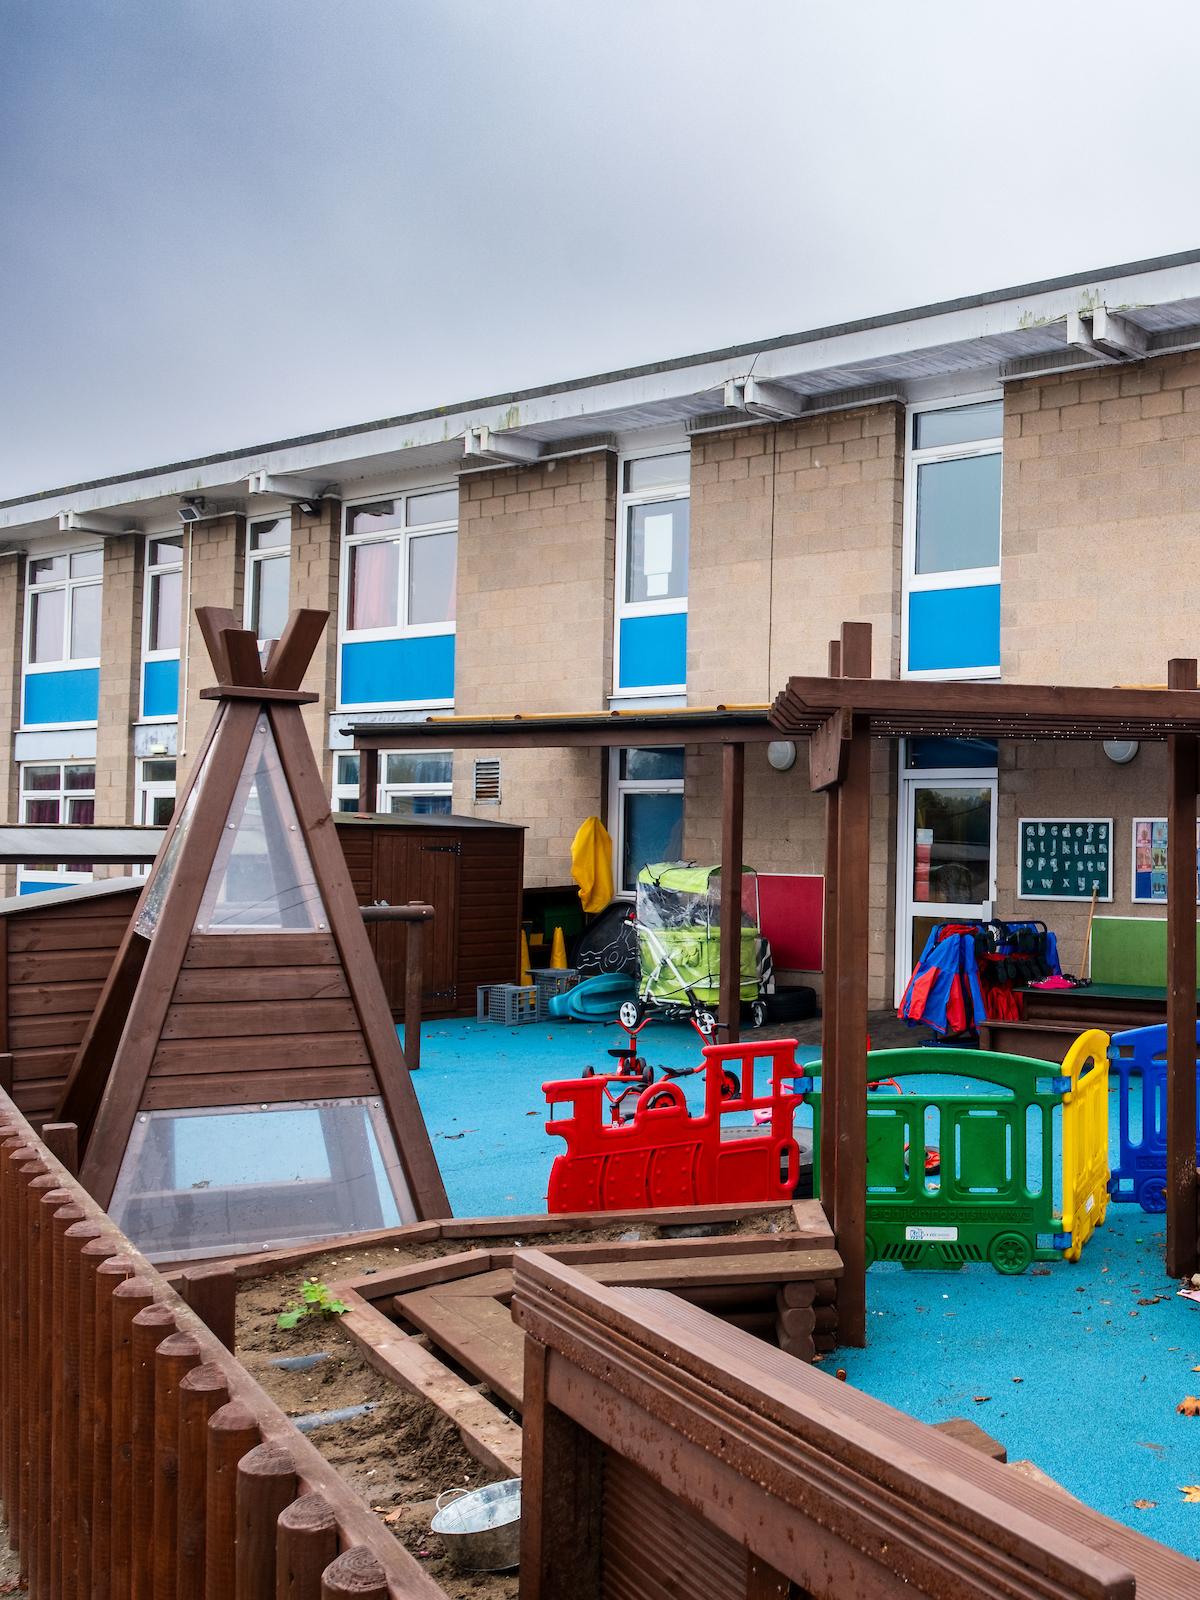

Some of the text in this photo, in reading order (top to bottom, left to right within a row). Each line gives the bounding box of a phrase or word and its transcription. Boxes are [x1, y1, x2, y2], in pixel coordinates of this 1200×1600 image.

[1026, 822, 1107, 843] a b c d e f g
[1026, 837, 1035, 852] h
[1049, 838, 1056, 857] j
[1062, 840, 1071, 854] k
[1083, 844, 1096, 854] m
[1098, 843, 1107, 854] n
[1025, 857, 1106, 872] o p q r s t u
[1026, 879, 1034, 889] v
[1041, 878, 1053, 889] w
[1062, 877, 1070, 887] x
[1077, 876, 1086, 892] y
